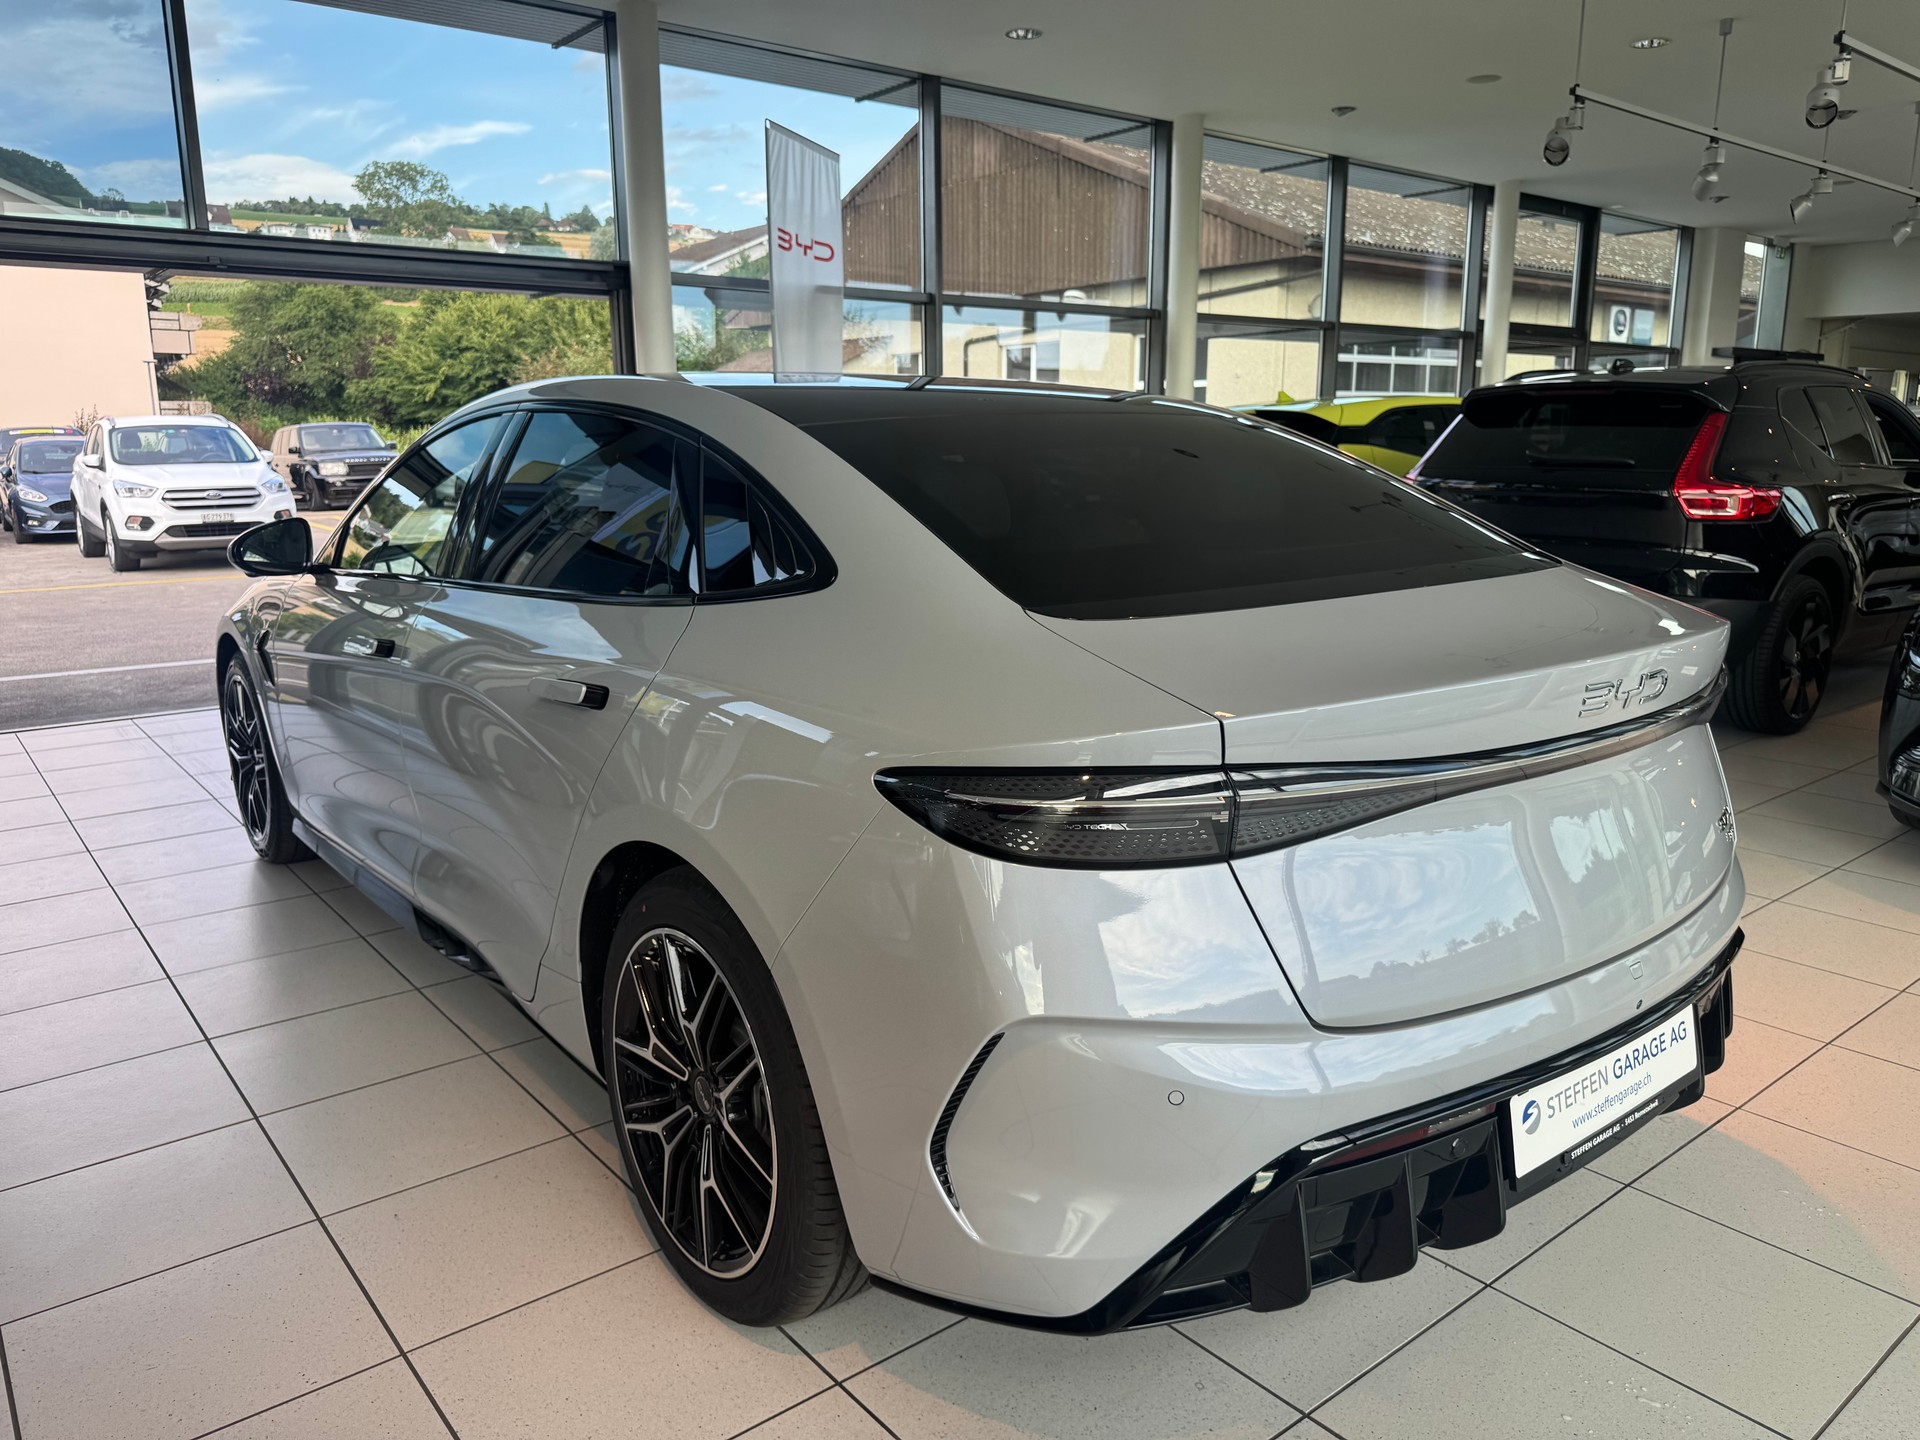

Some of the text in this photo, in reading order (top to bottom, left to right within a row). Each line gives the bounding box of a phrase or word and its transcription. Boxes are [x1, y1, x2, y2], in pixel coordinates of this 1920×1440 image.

[777, 227, 835, 263] BYD
[1578, 668, 1669, 718] BYD
[1546, 1020, 1688, 1119] STEFFEN GARAGE AG
[1571, 1072, 1652, 1129] www.steffengarage.ch
[1571, 1140, 1593, 1159] STEFFEN
[1592, 1127, 1613, 1146] GARAGE
[1612, 1123, 1621, 1134] AG
